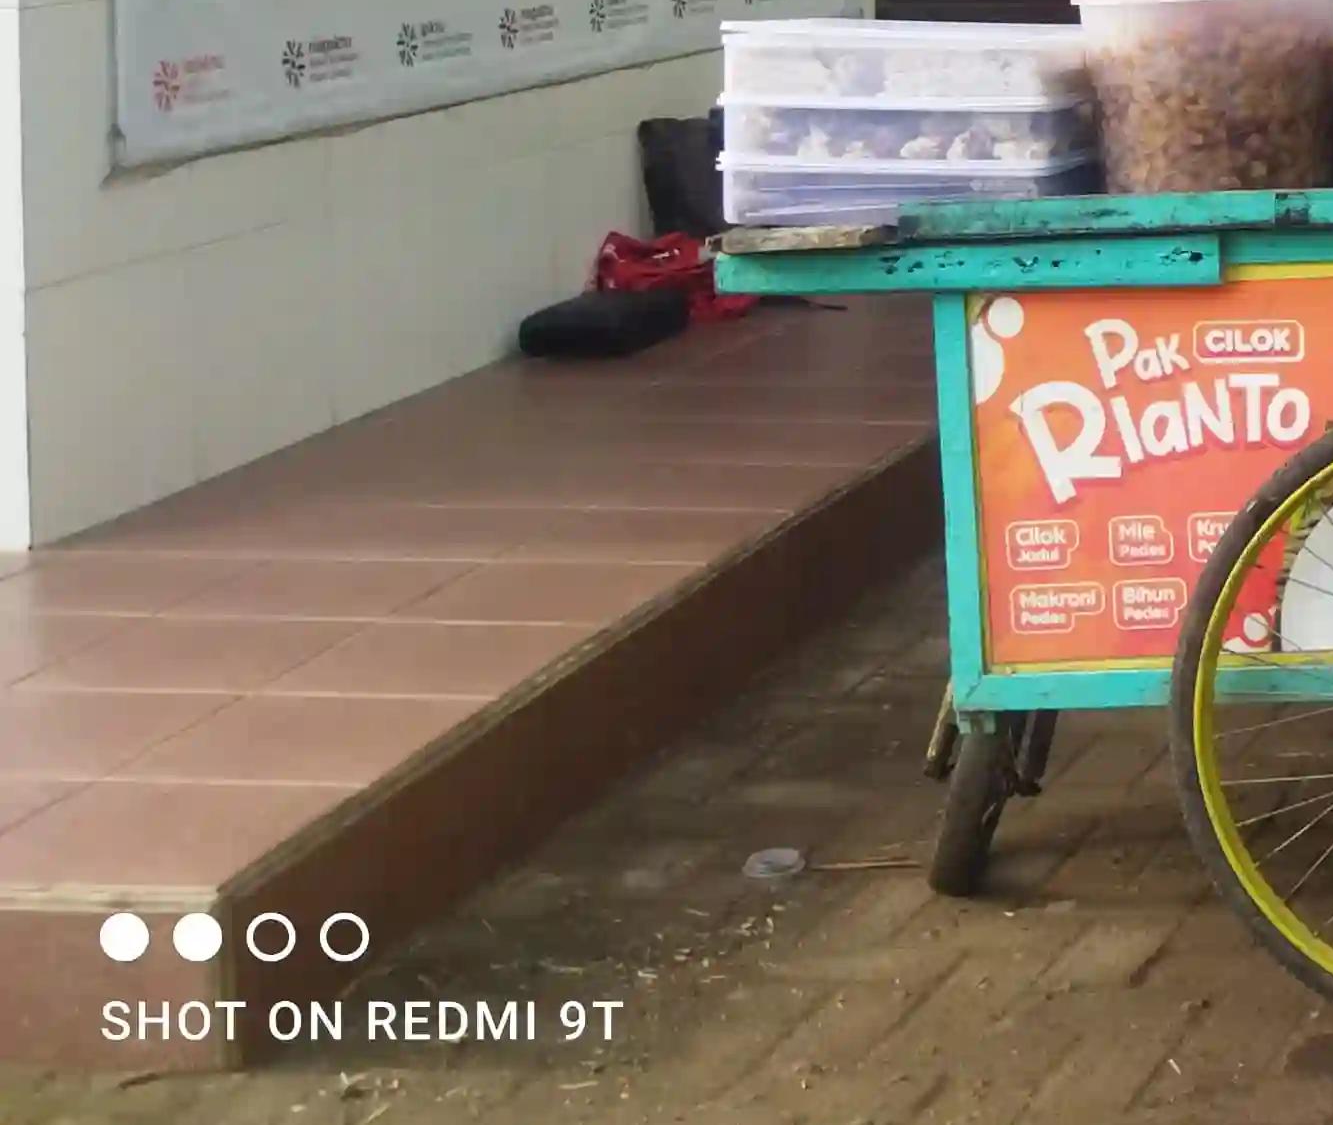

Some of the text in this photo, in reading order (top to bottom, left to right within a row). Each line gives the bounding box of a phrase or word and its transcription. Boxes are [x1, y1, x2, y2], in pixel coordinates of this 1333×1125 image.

[1204, 327, 1291, 353] CILOK
[1016, 525, 1067, 547] Cilok
[1118, 523, 1156, 541] Mie
[1019, 590, 1097, 609] Makroni
[1122, 586, 1175, 605] Bihun
